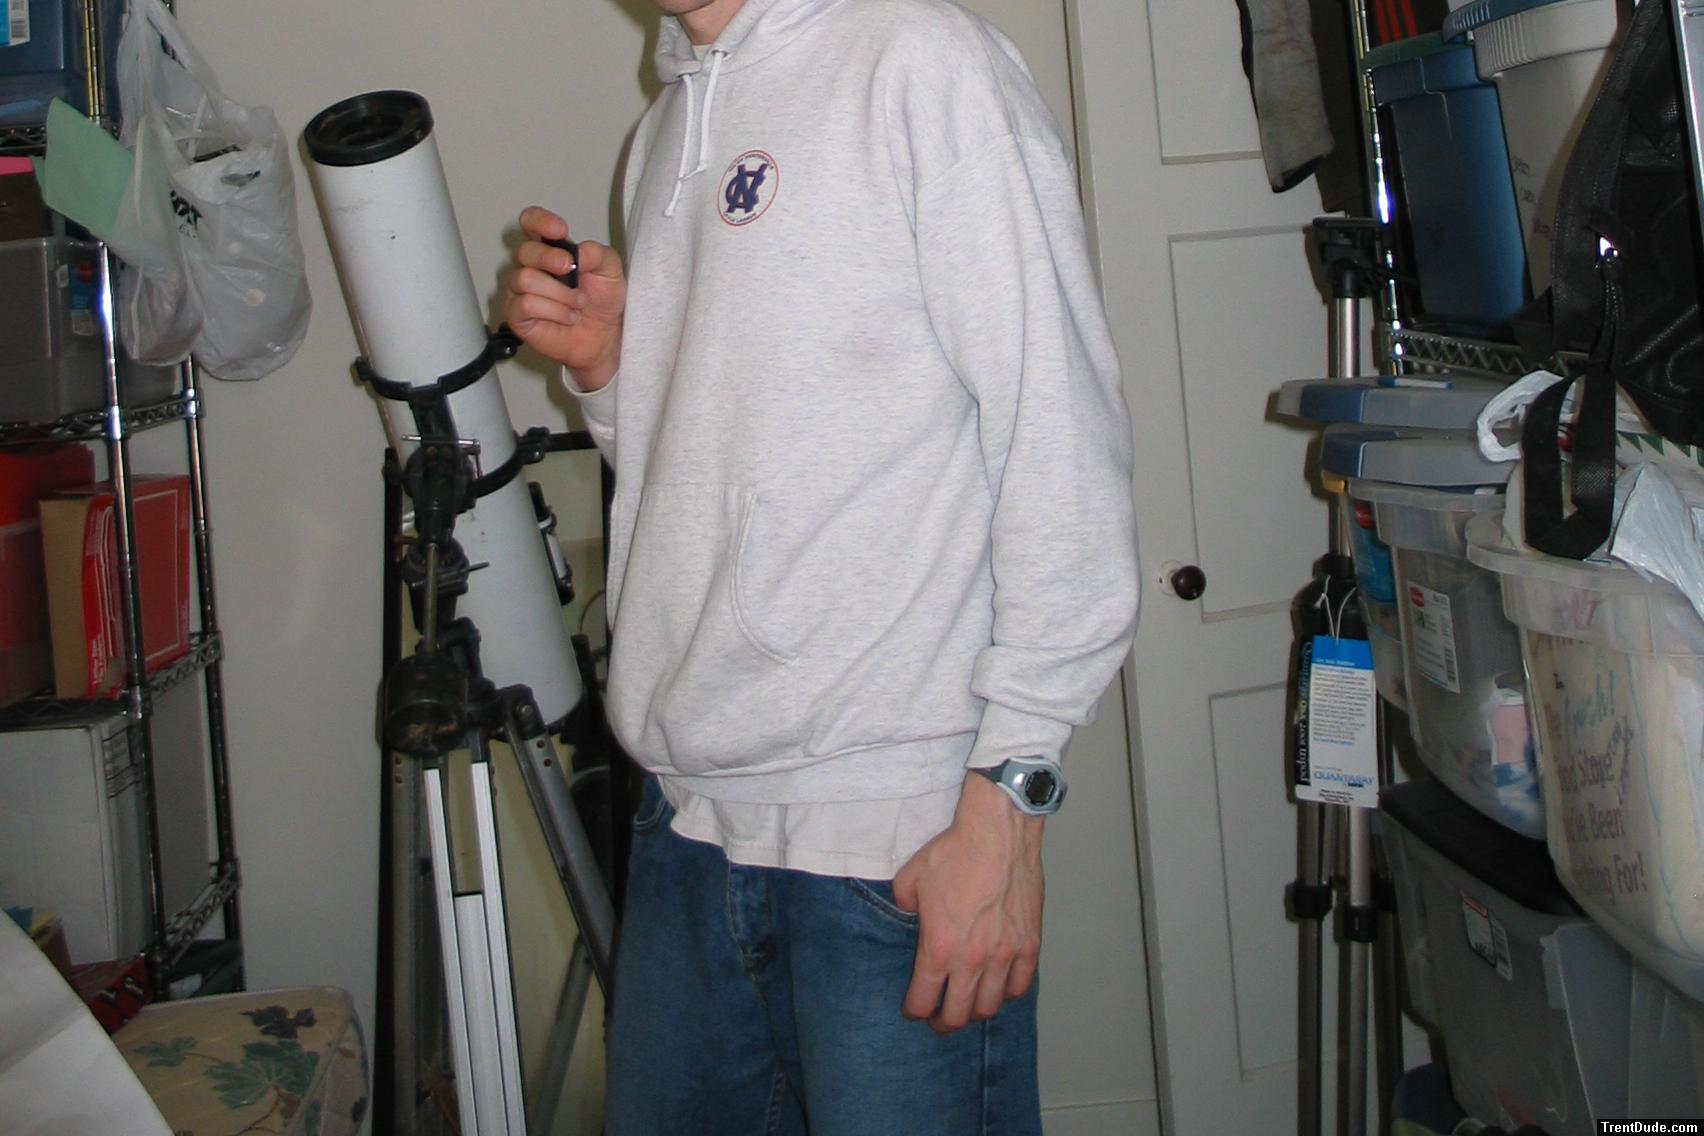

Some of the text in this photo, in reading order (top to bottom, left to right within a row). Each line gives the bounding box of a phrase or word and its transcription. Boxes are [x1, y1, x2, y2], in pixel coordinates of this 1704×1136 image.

[1313, 769, 1375, 785] QUANTARAY
[1588, 802, 1625, 840] Been
[1613, 850, 1648, 895] For!
